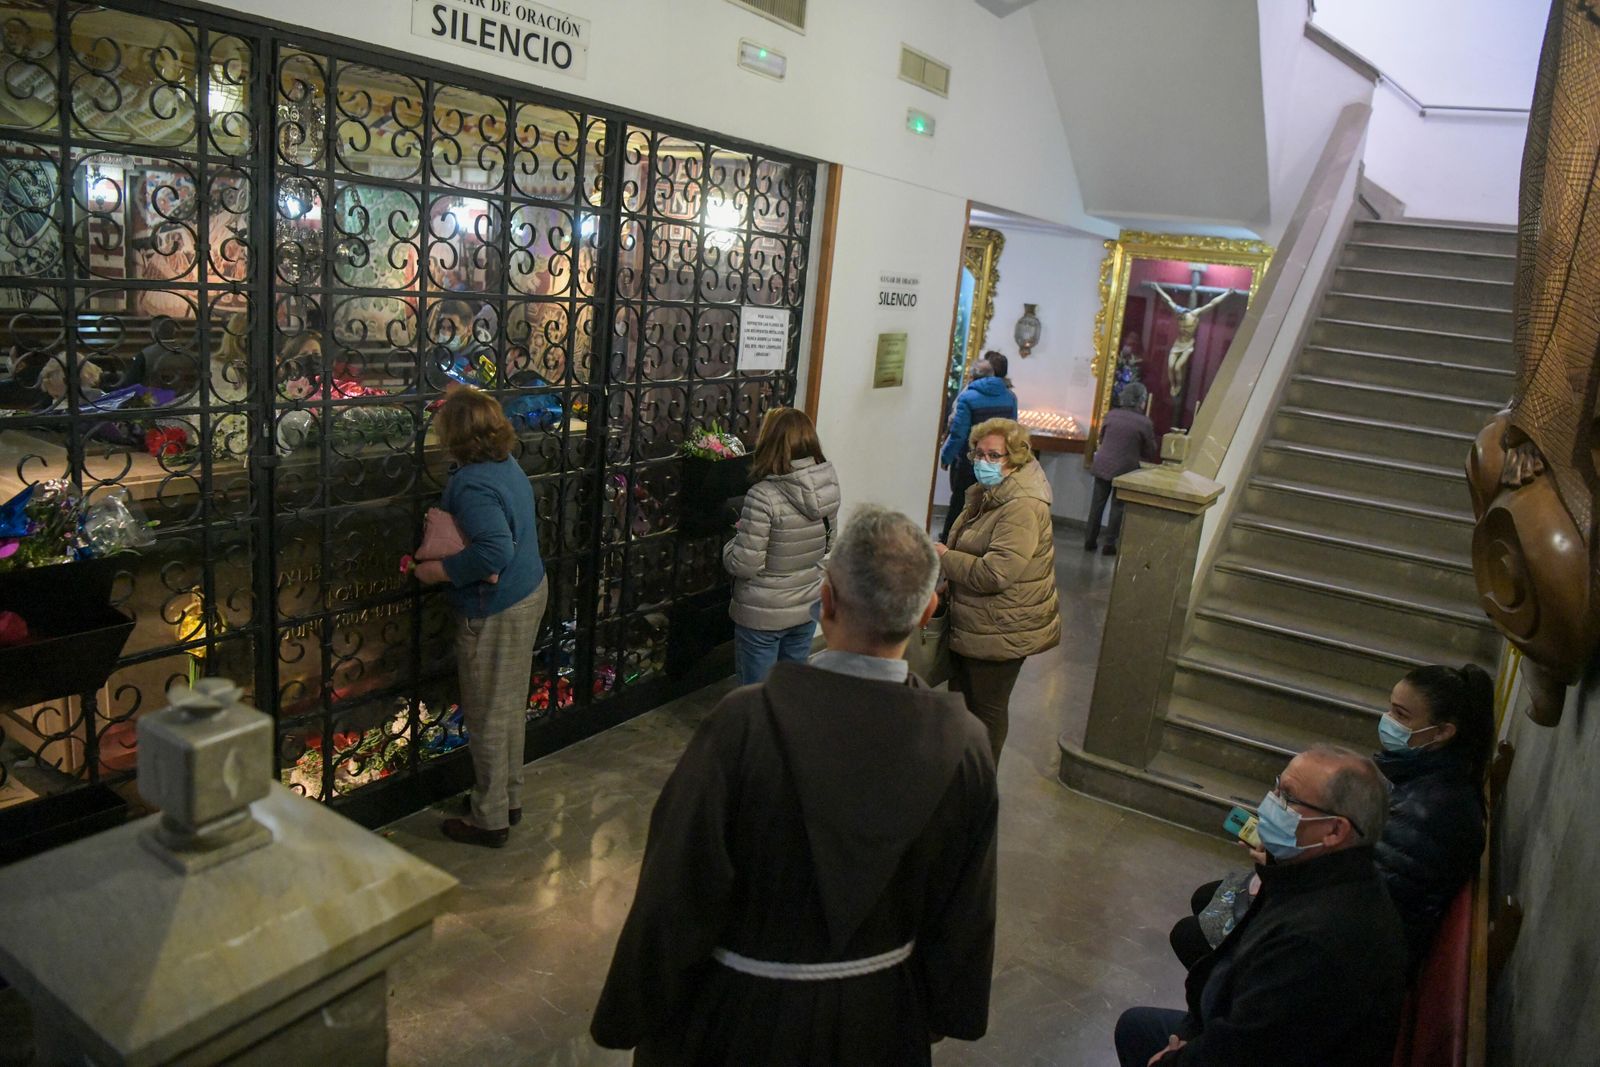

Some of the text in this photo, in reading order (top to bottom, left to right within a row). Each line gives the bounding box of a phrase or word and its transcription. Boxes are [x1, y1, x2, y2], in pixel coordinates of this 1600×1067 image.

[431, 4, 572, 69] SILENCIO
[491, 0, 581, 38] DE ORACIÓN
[878, 291, 917, 307] SILENCIO
